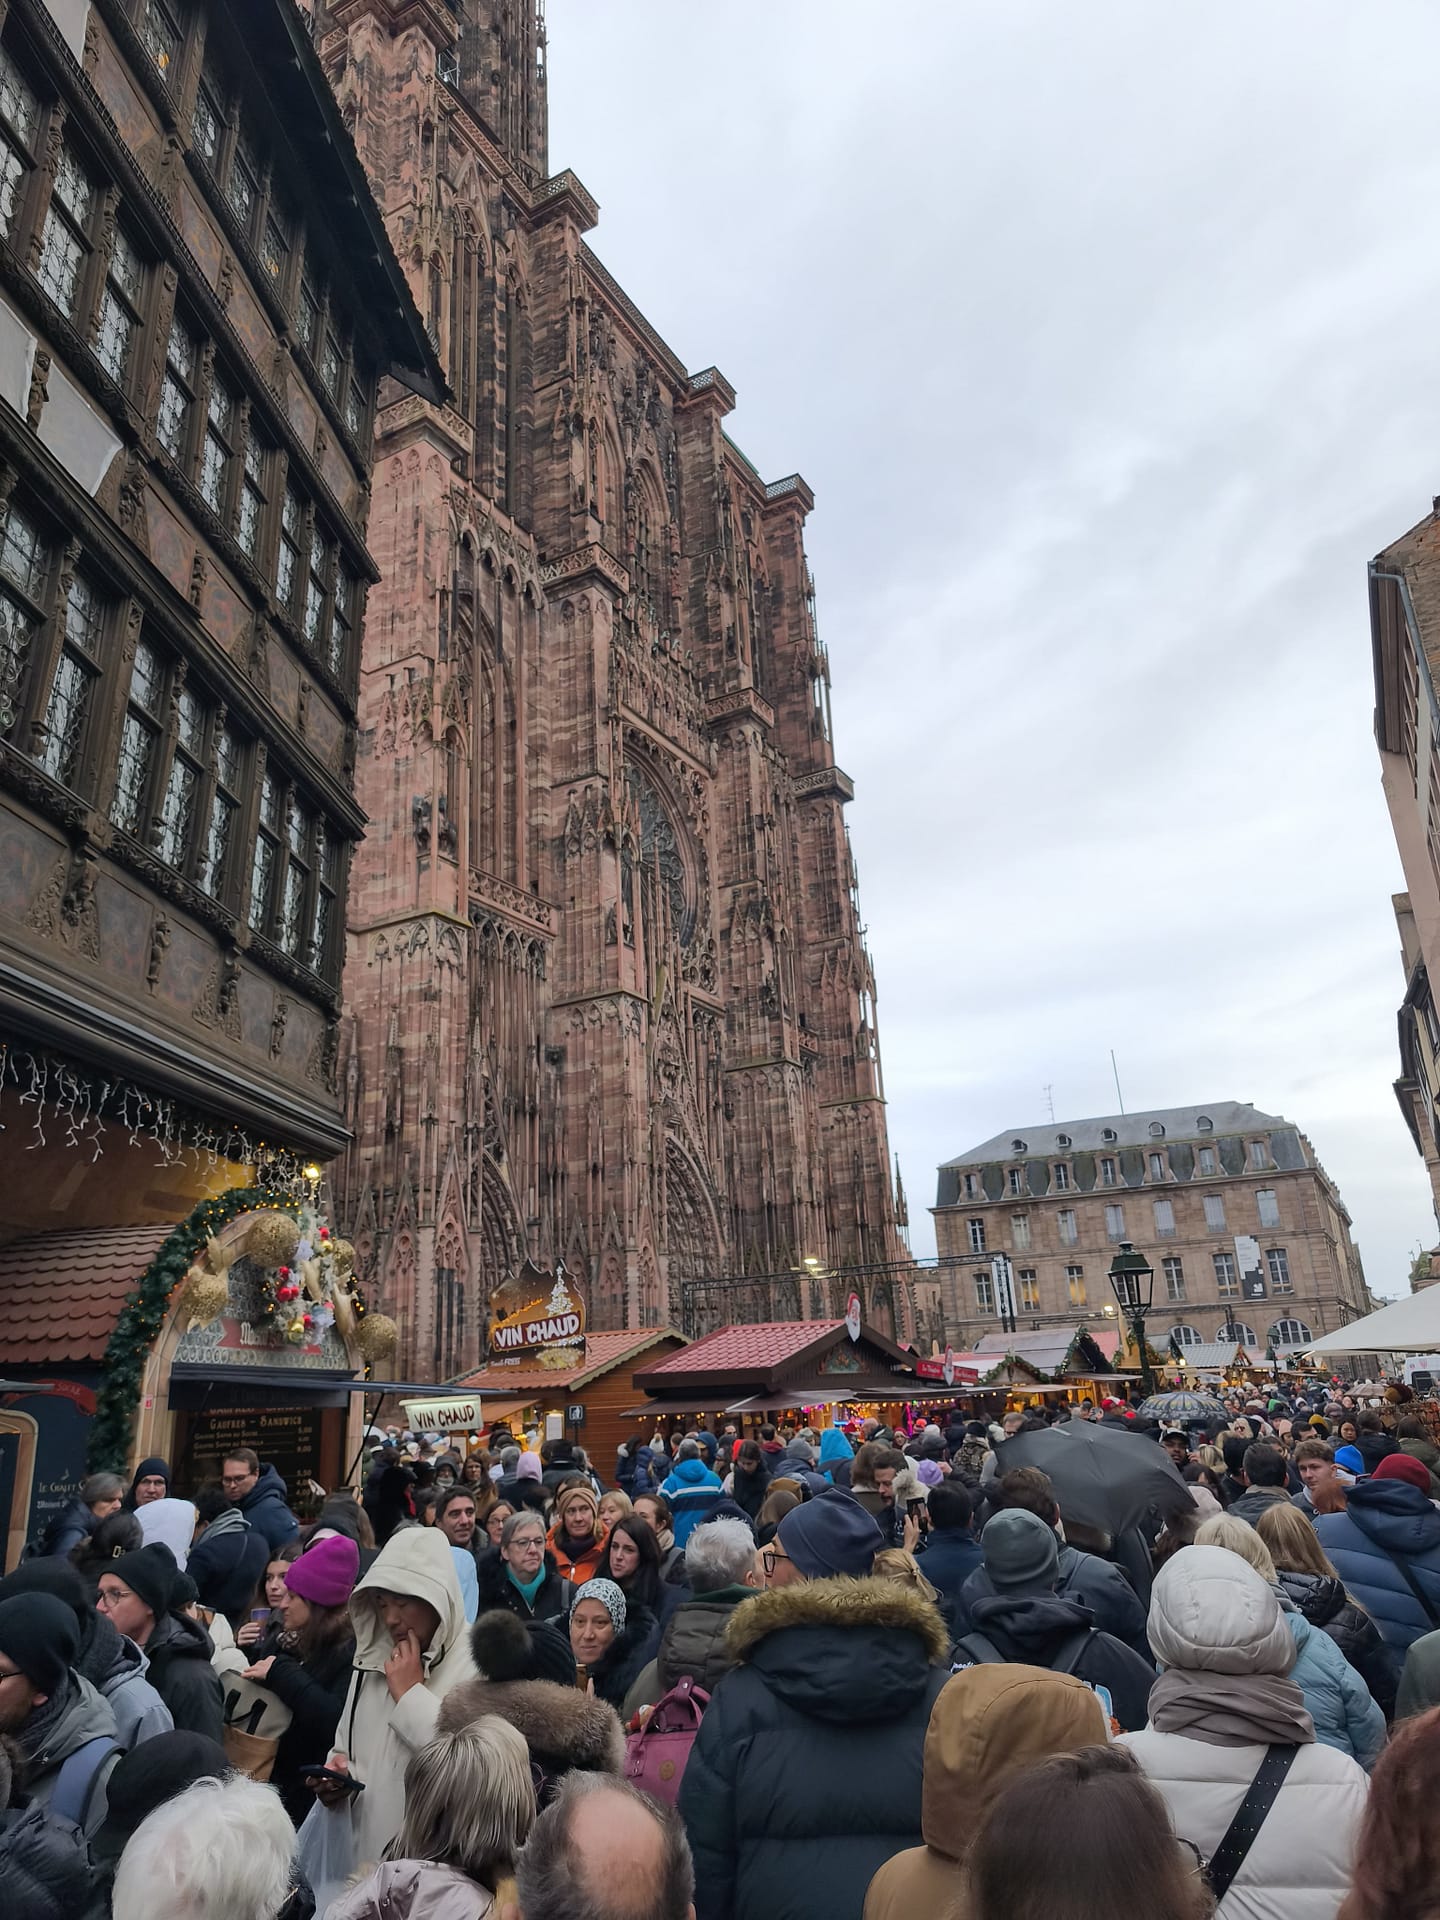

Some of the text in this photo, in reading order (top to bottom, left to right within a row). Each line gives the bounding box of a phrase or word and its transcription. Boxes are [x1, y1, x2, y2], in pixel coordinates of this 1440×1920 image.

[496, 1314, 579, 1347] VIN CHAUD
[414, 1404, 475, 1429] VIN CHAUD
